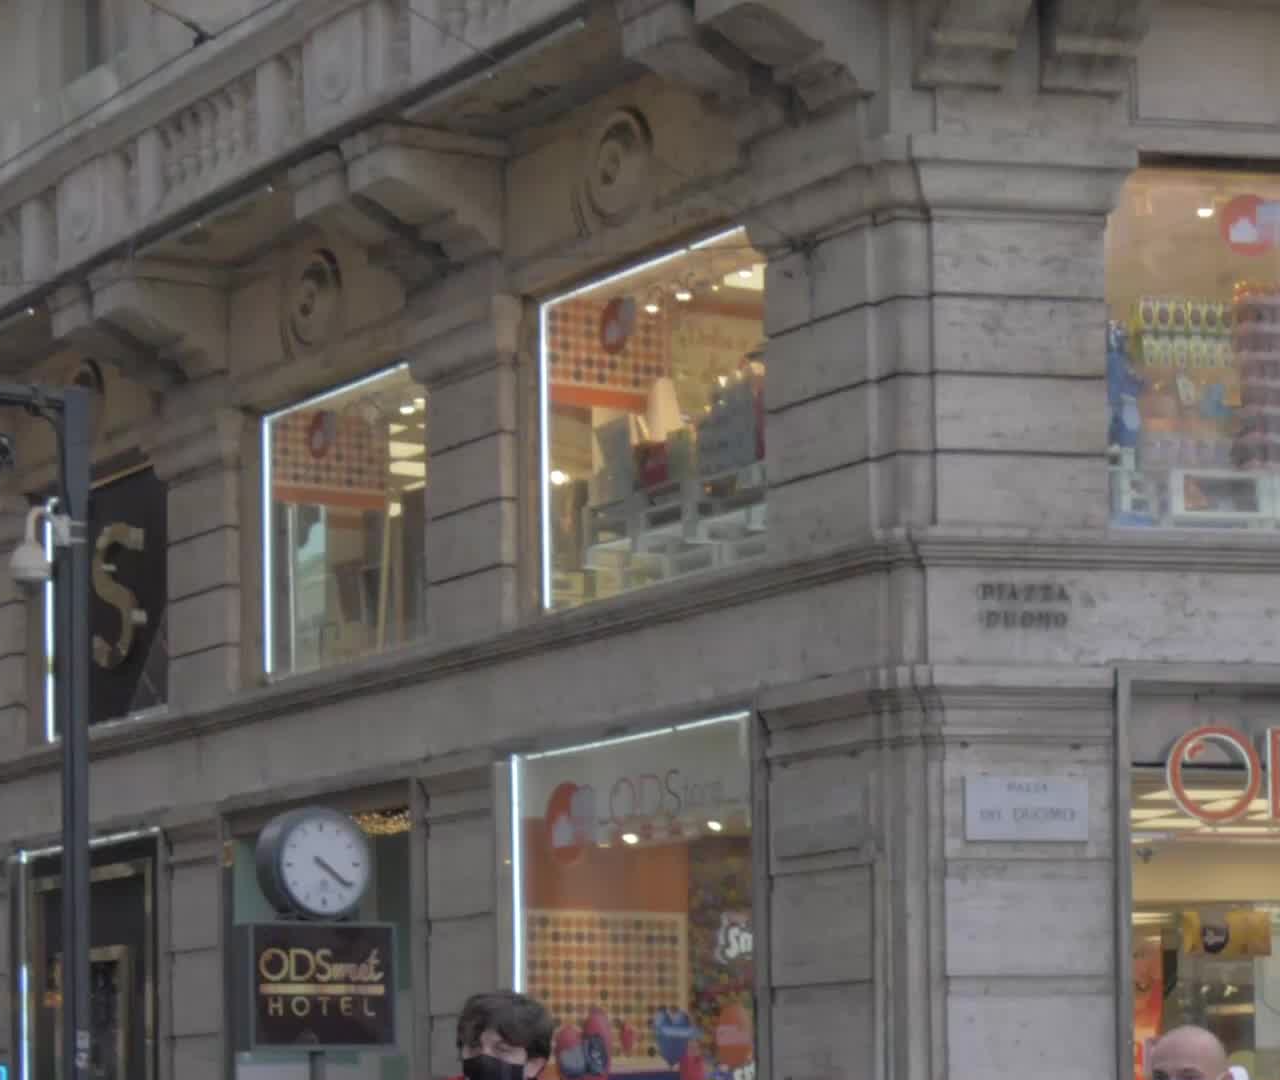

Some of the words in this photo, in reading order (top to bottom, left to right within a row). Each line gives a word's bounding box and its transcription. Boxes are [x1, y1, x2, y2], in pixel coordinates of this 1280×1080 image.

[979, 583, 1070, 602] PIAZZA
[1013, 807, 1077, 823] DUOMO
[268, 996, 377, 1017] HOTEL
